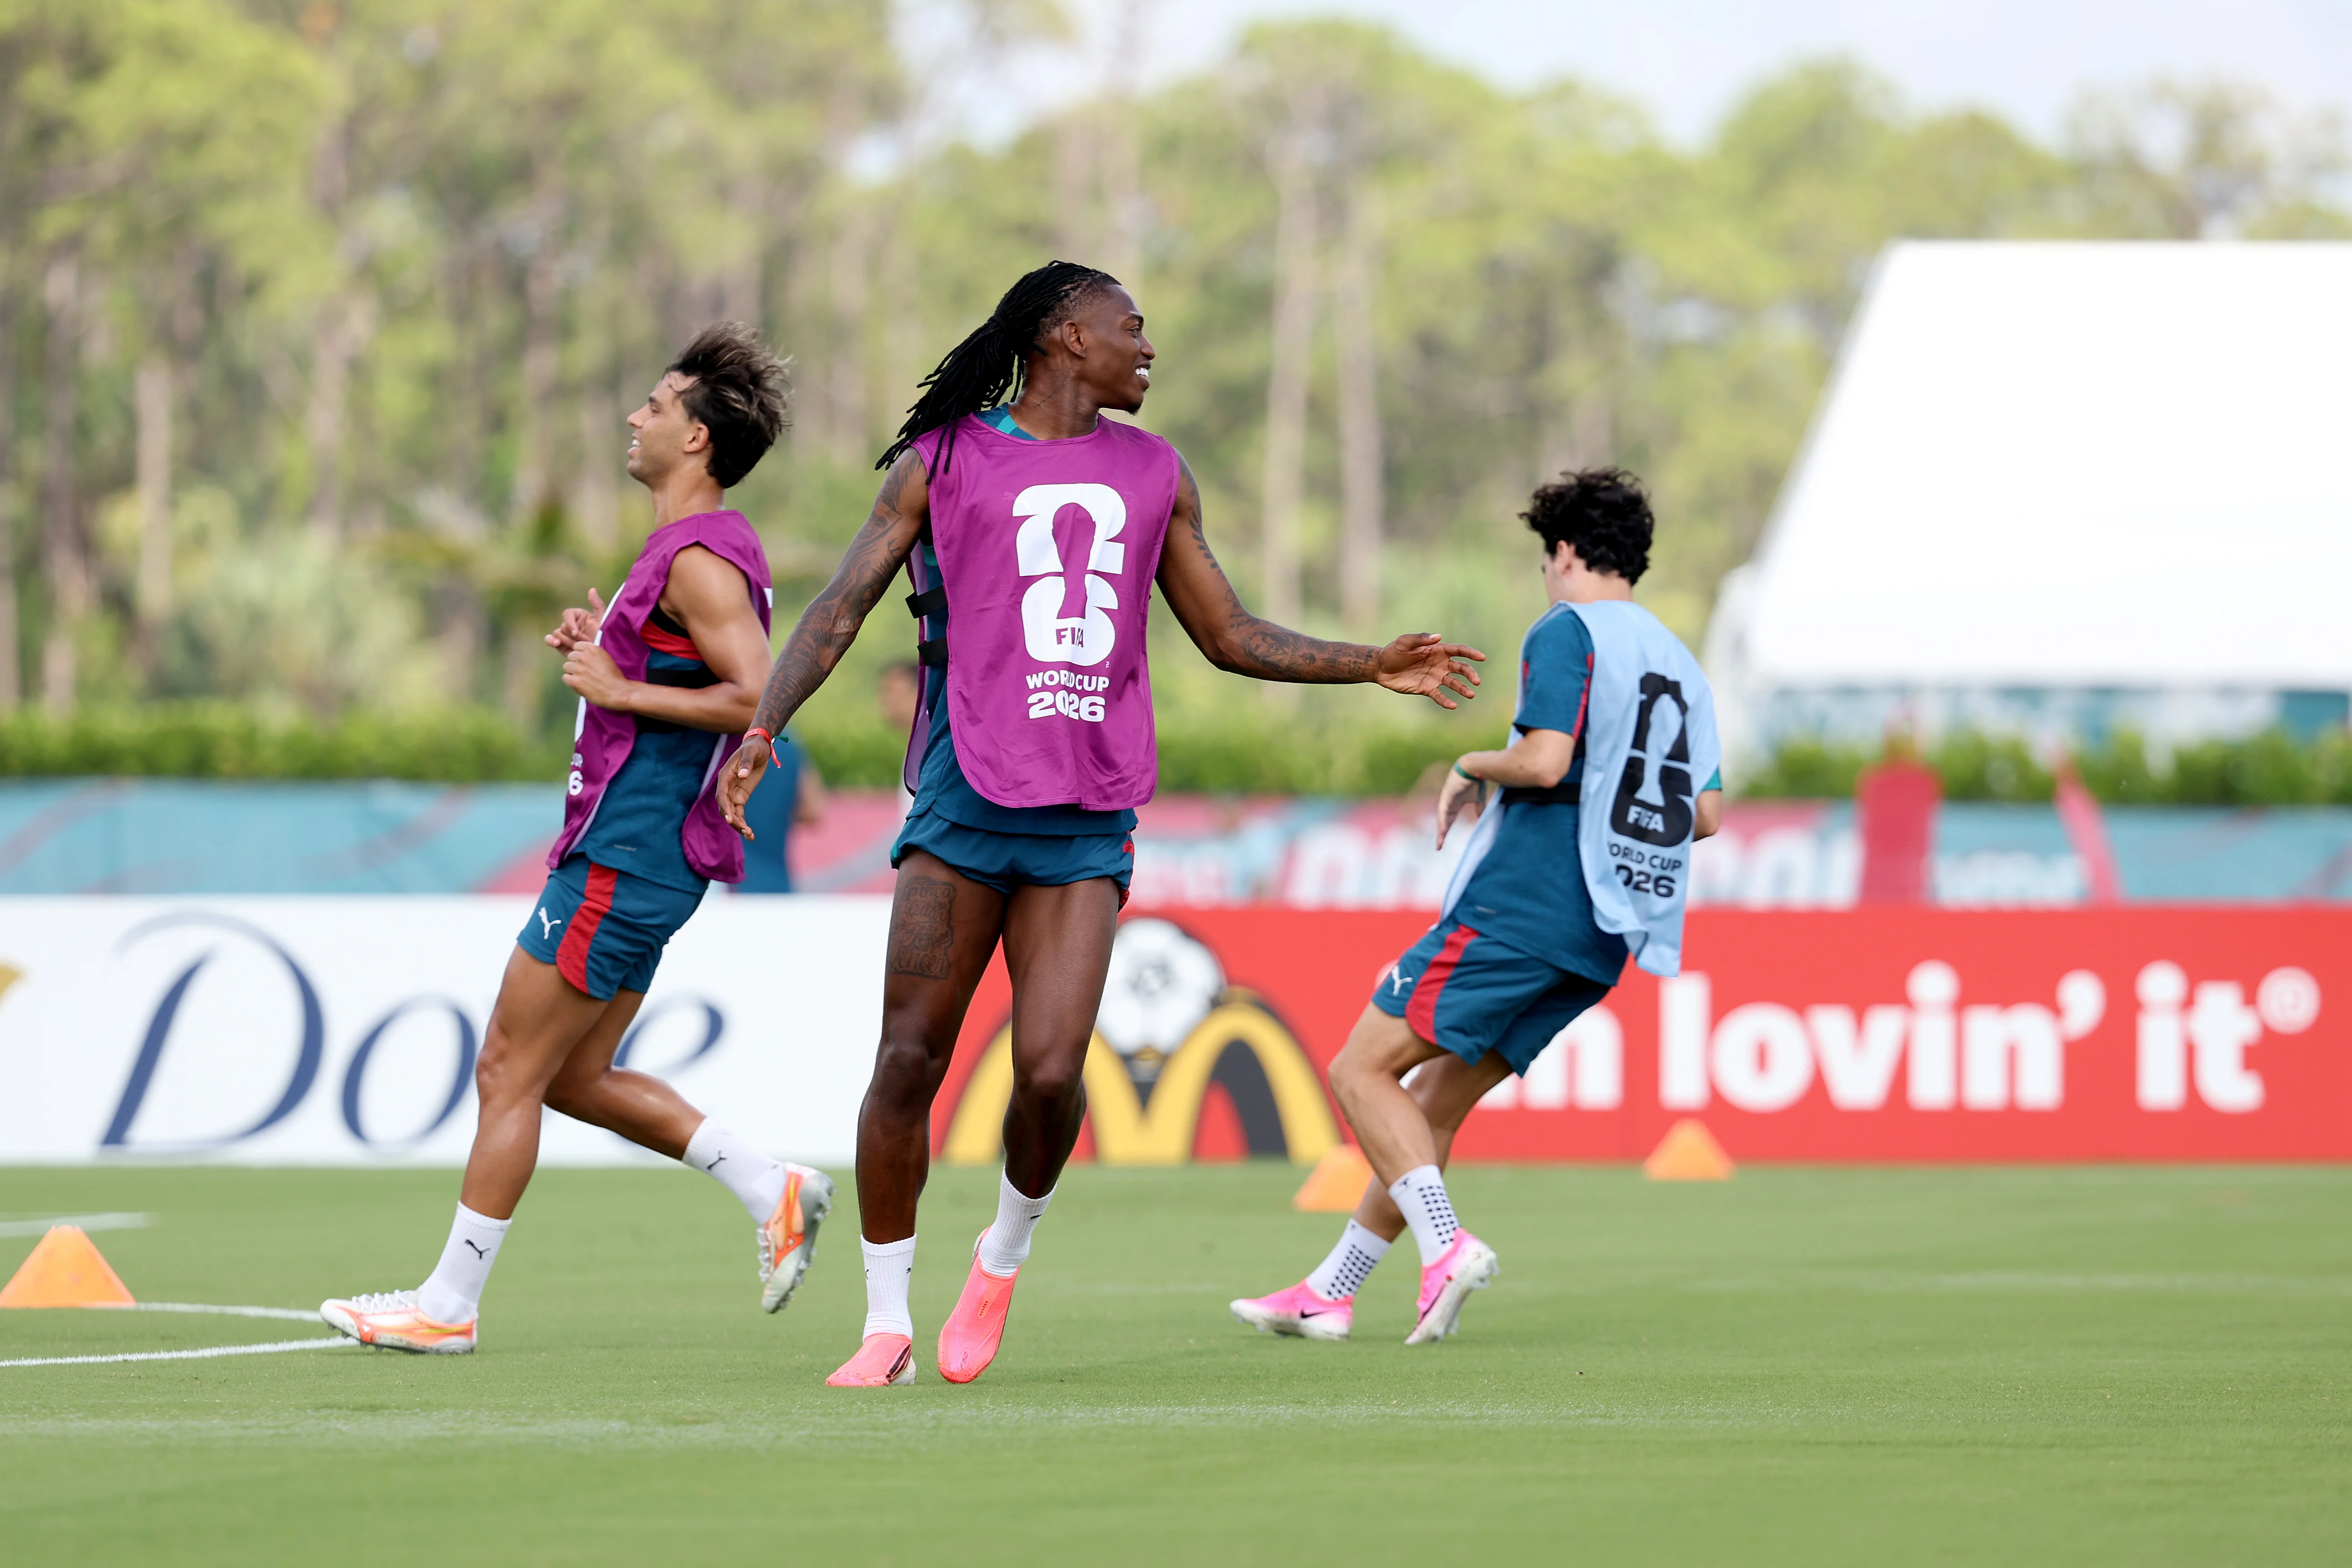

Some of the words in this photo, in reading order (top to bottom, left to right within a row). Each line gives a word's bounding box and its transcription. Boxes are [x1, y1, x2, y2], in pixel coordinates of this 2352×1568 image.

[1075, 674, 1110, 692] CUP
[1027, 690, 1106, 722] 2026
[1607, 841, 1644, 864] ORLD
[1649, 855, 1682, 871] CUP
[1615, 865, 1675, 898] 026
[94, 907, 725, 1156] Doe
